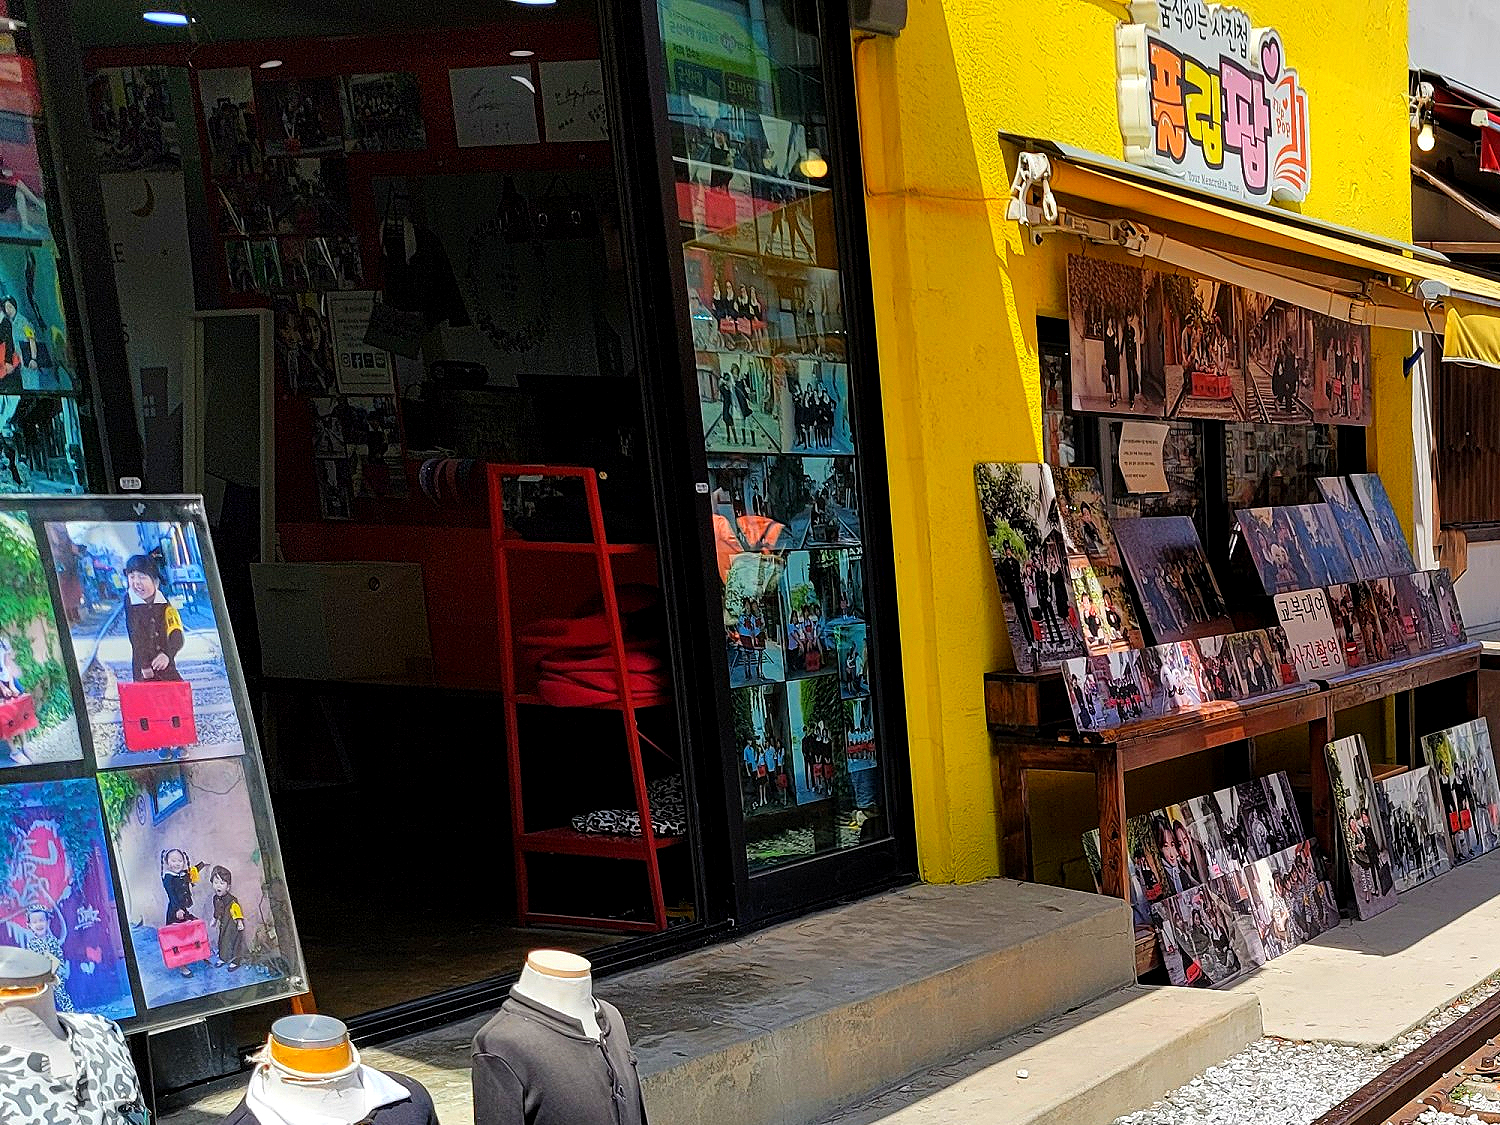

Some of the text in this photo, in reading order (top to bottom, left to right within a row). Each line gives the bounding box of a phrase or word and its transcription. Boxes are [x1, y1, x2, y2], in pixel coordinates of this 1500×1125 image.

[1212, 15, 1248, 59] 사진첩
[1279, 593, 1329, 623] 교복대여
[1293, 637, 1341, 672] 사진촬영
